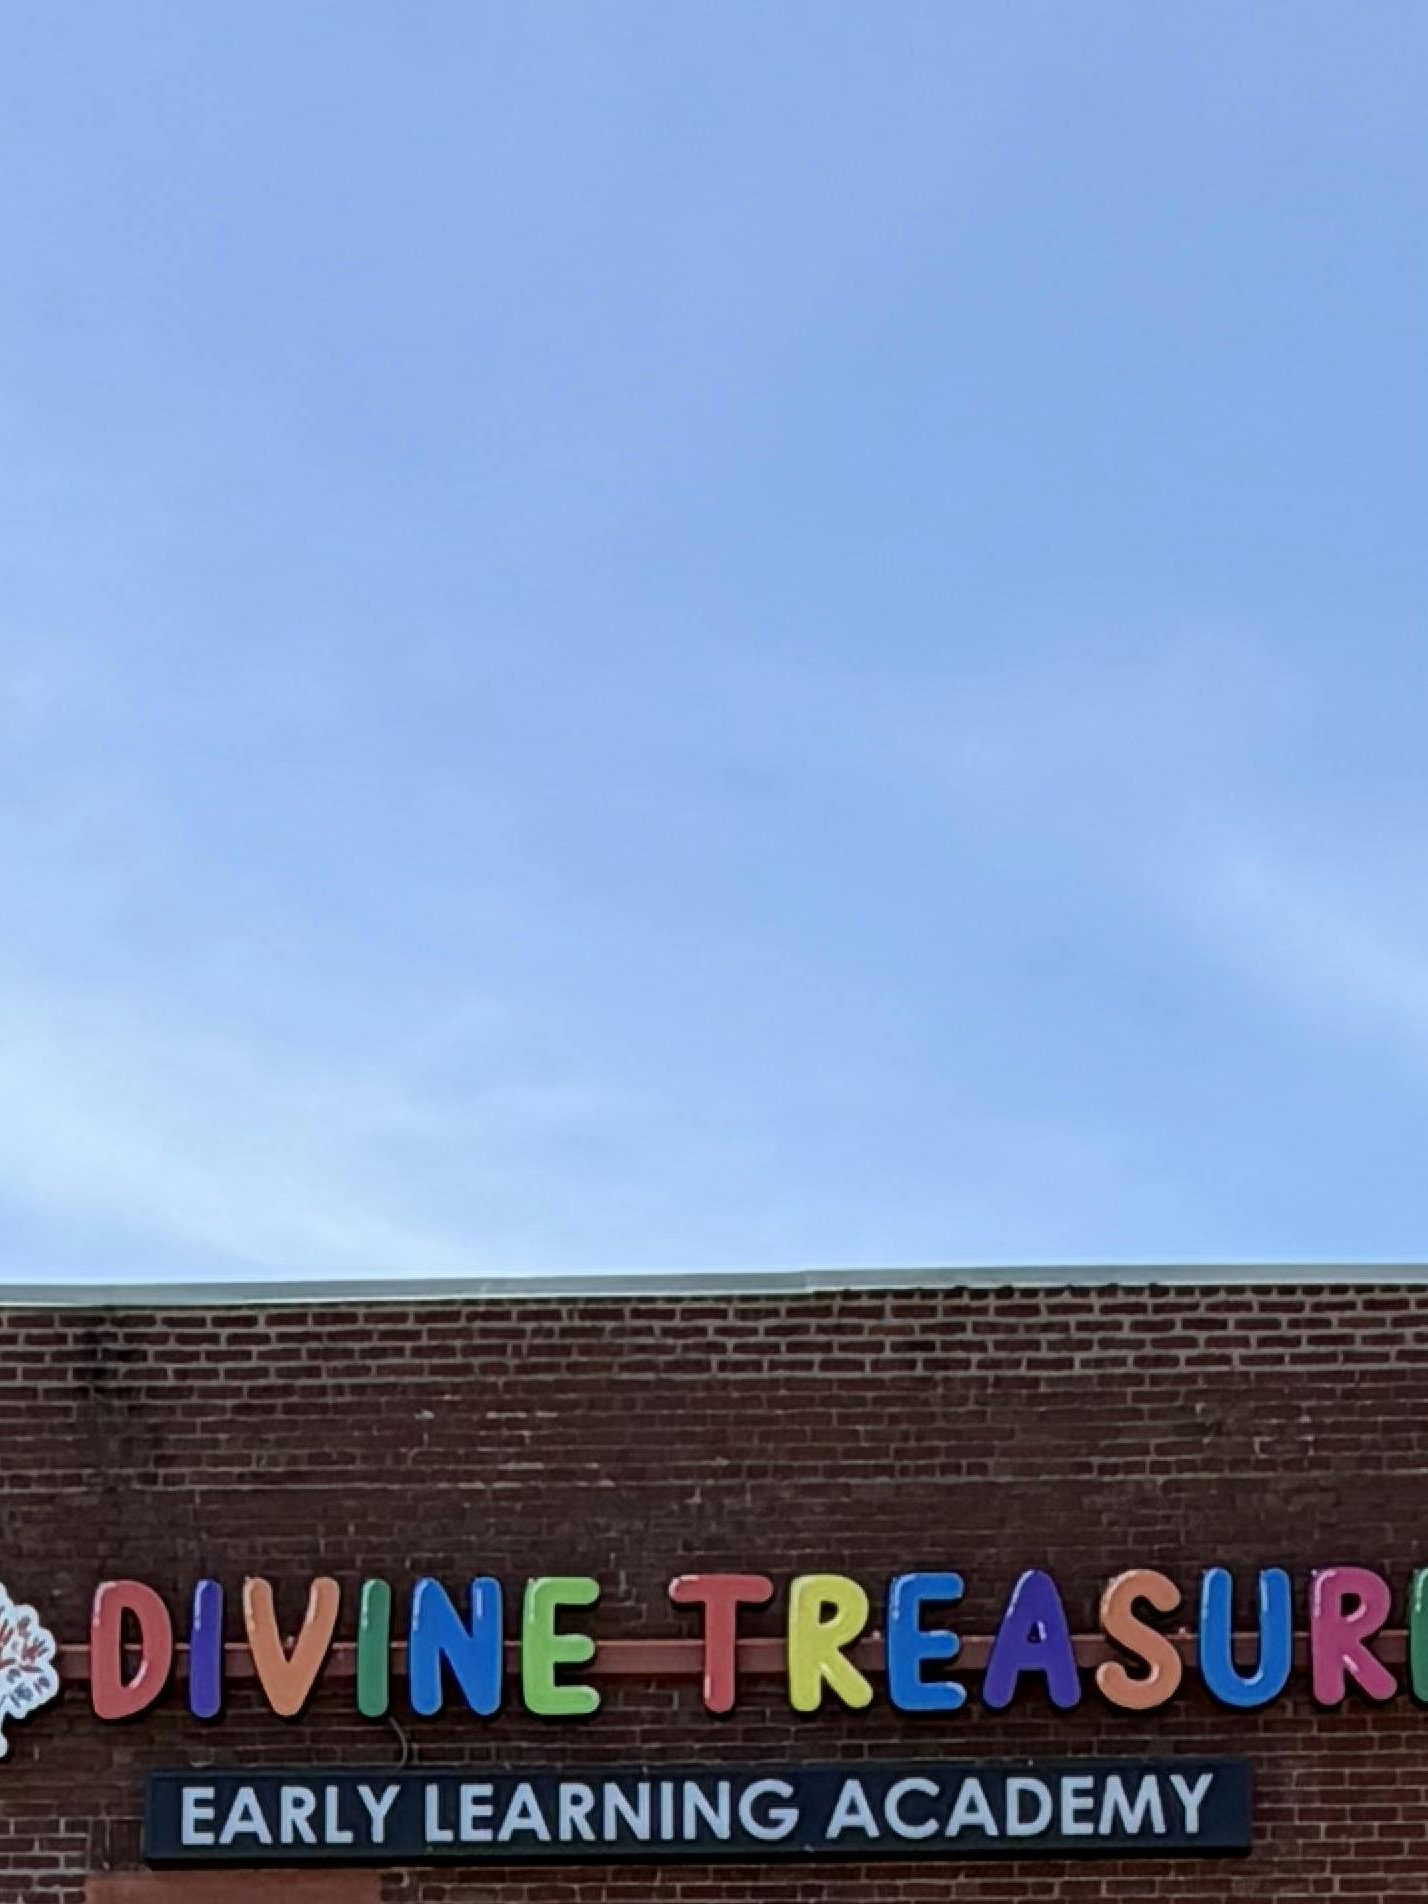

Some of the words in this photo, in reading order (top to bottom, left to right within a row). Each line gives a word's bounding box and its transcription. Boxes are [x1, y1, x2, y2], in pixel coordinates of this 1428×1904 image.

[90, 1576, 601, 1720] DIVINE
[180, 1785, 401, 1847] EARLY
[425, 1778, 799, 1843] LEARNING
[826, 1773, 1214, 1840] ACADEMY
